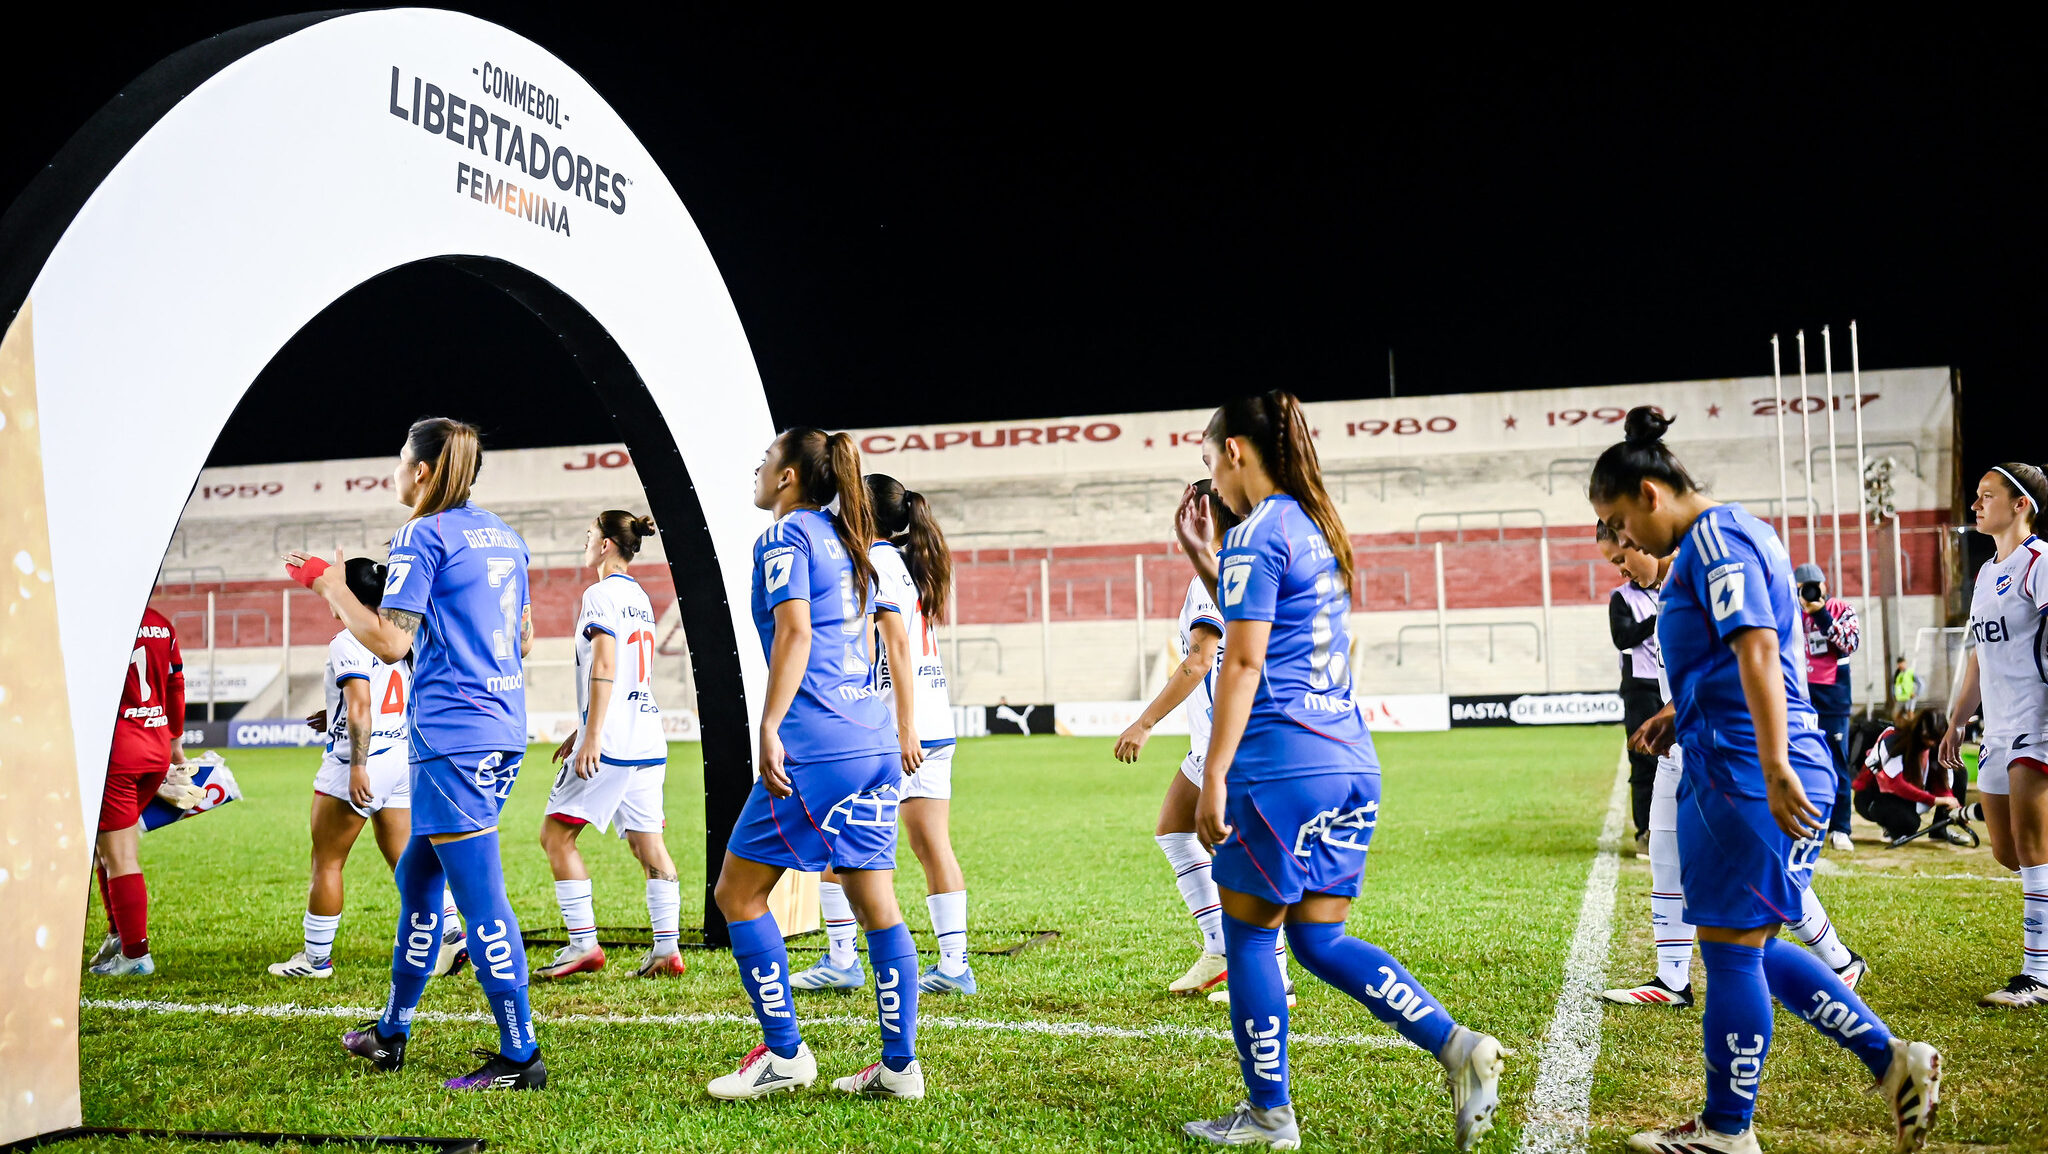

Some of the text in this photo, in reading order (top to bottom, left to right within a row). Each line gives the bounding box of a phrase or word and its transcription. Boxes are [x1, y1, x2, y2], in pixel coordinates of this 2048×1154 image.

[483, 61, 562, 130] CONMEBOL
[390, 65, 627, 215] LIBERTADORES
[457, 161, 570, 237] FEMENINA
[1547, 406, 1664, 427] 199
[1752, 393, 1880, 415] 2017
[860, 423, 1121, 454] CAPURRO
[1346, 416, 1457, 437] 1980
[203, 482, 284, 499] 1959
[130, 645, 152, 703] 1
[381, 669, 405, 717] 4
[1452, 699, 1620, 721] BASTA DE RACISMO
[236, 724, 327, 746] CONMEBO
[503, 999, 523, 1049] WONDER
